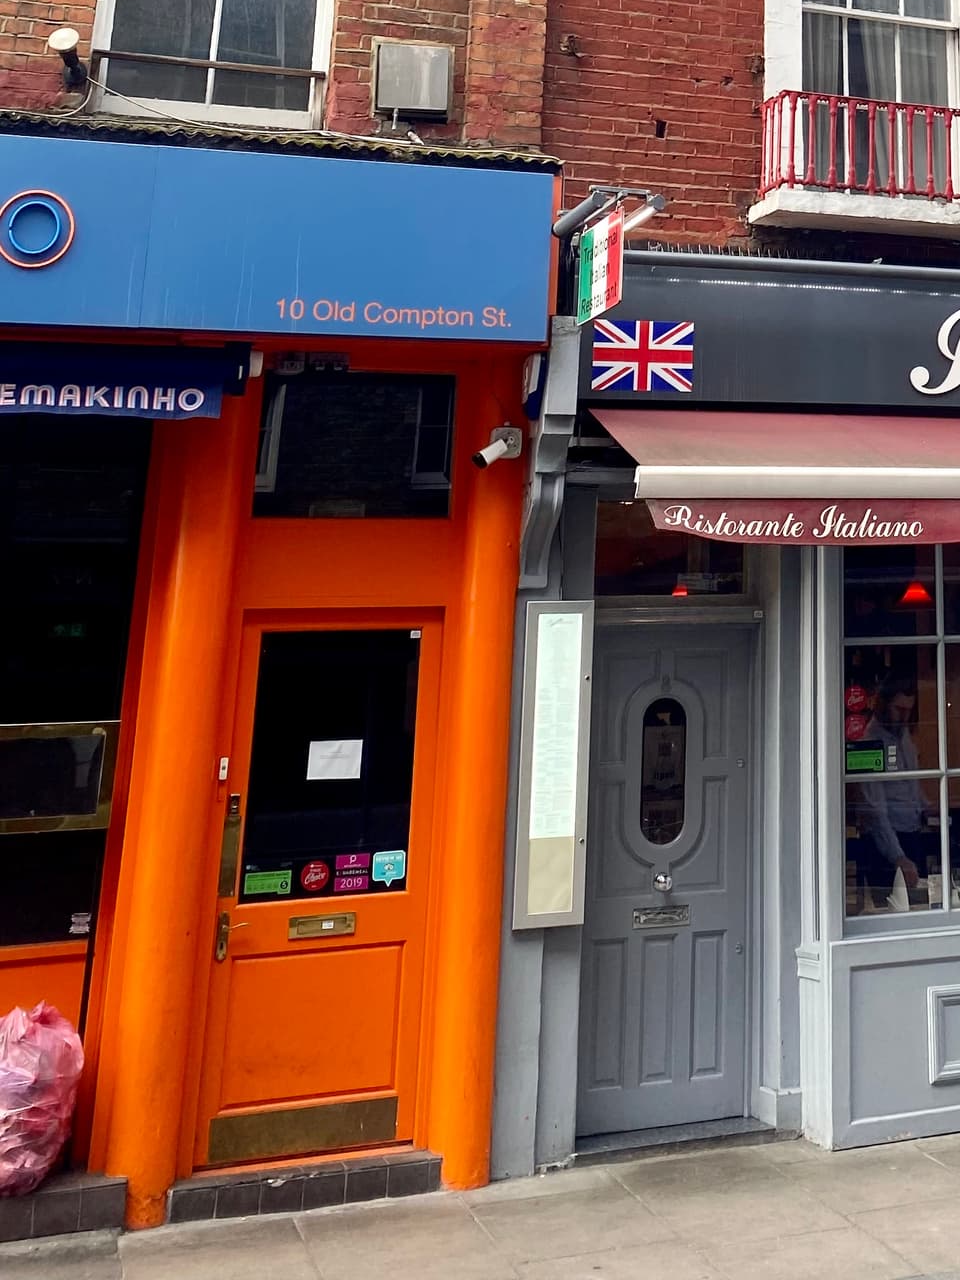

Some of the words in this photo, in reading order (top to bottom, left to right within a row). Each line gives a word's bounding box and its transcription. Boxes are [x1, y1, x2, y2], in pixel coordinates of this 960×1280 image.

[276, 298, 305, 320] 10
[313, 299, 356, 322] Old
[363, 302, 473, 329] Compton
[481, 306, 512, 328] St.
[664, 505, 804, 538] Ristorante
[812, 505, 924, 538] Italiano
[340, 877, 363, 889] 2019
